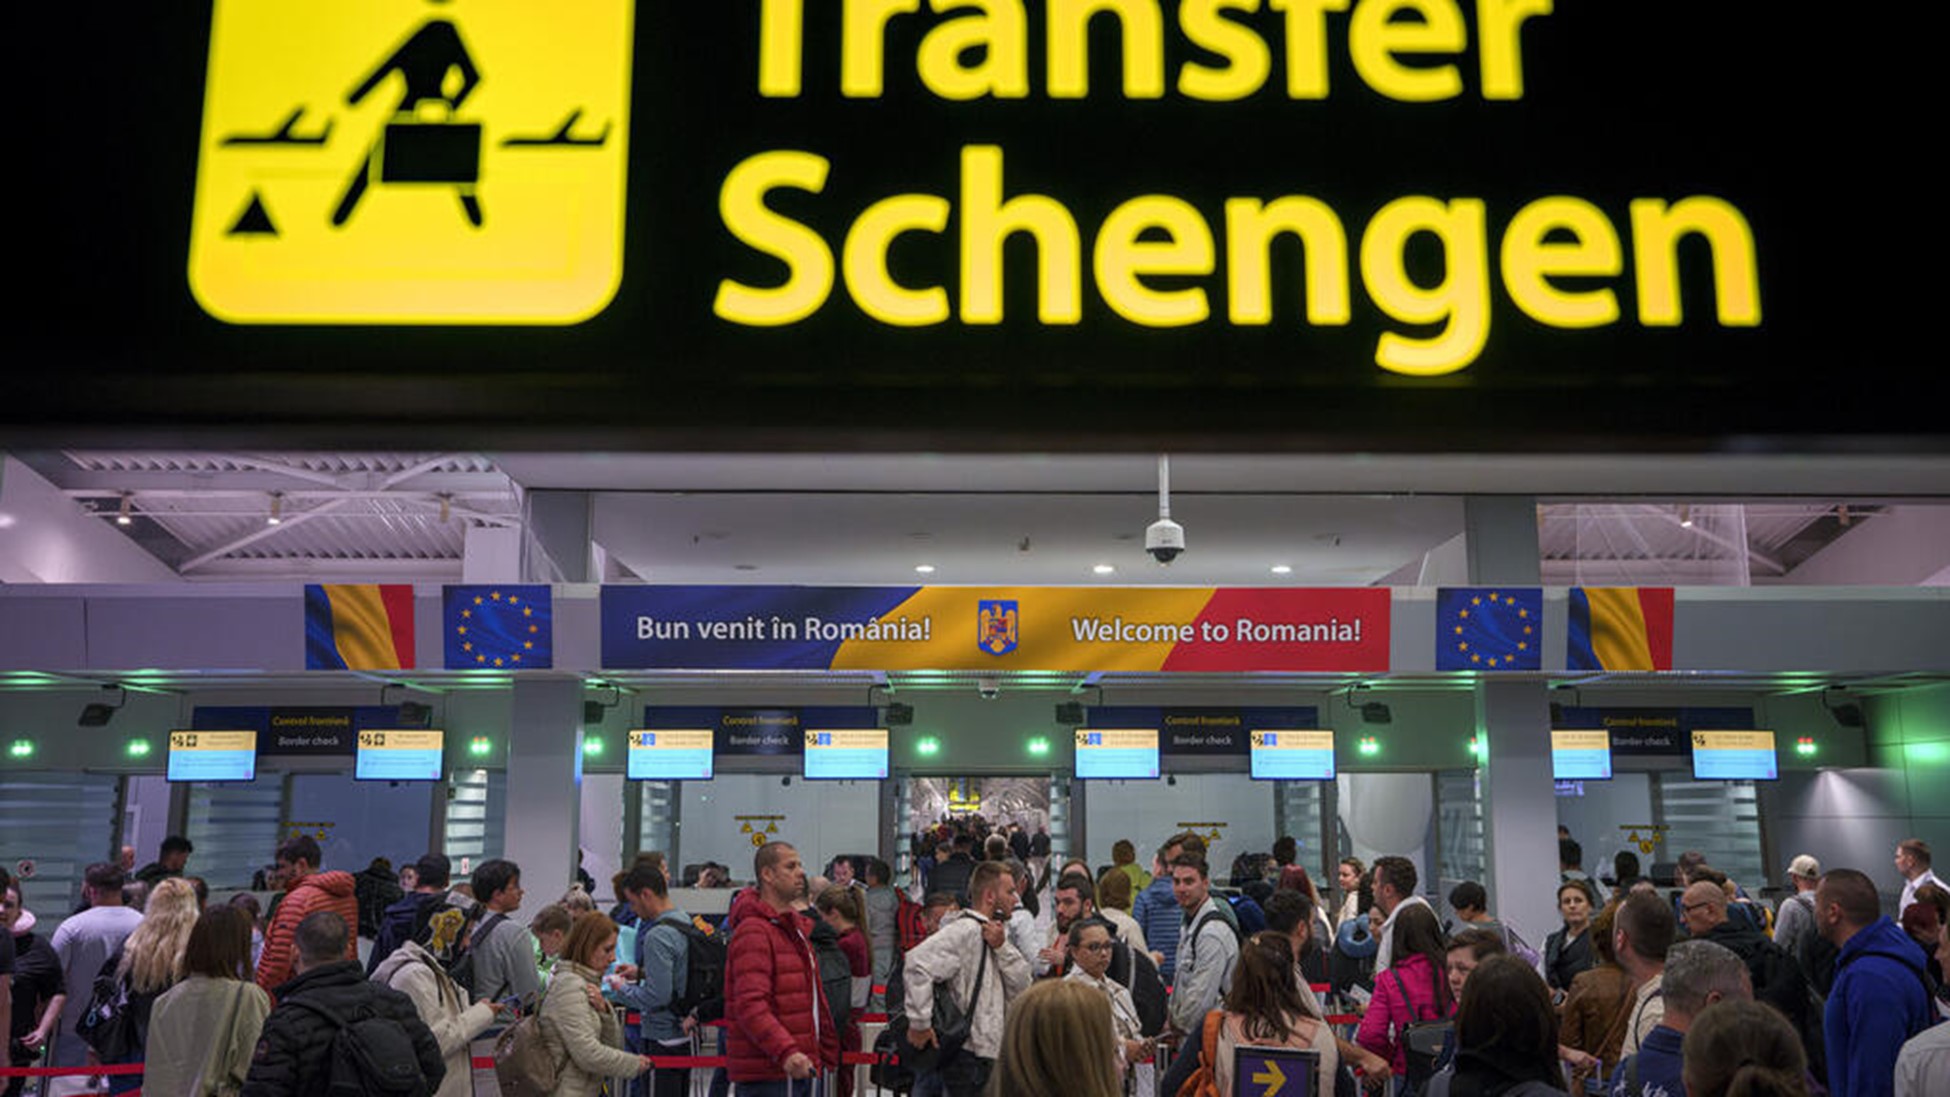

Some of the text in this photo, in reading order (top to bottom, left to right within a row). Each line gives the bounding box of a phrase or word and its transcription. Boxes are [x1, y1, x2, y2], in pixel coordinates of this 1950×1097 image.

[713, 145, 1763, 376] Schengen
[637, 616, 931, 640] Bun venit în România!
[1072, 618, 1360, 642] Welcome to Romania!
[312, 736, 339, 746] check
[762, 735, 790, 745] check
